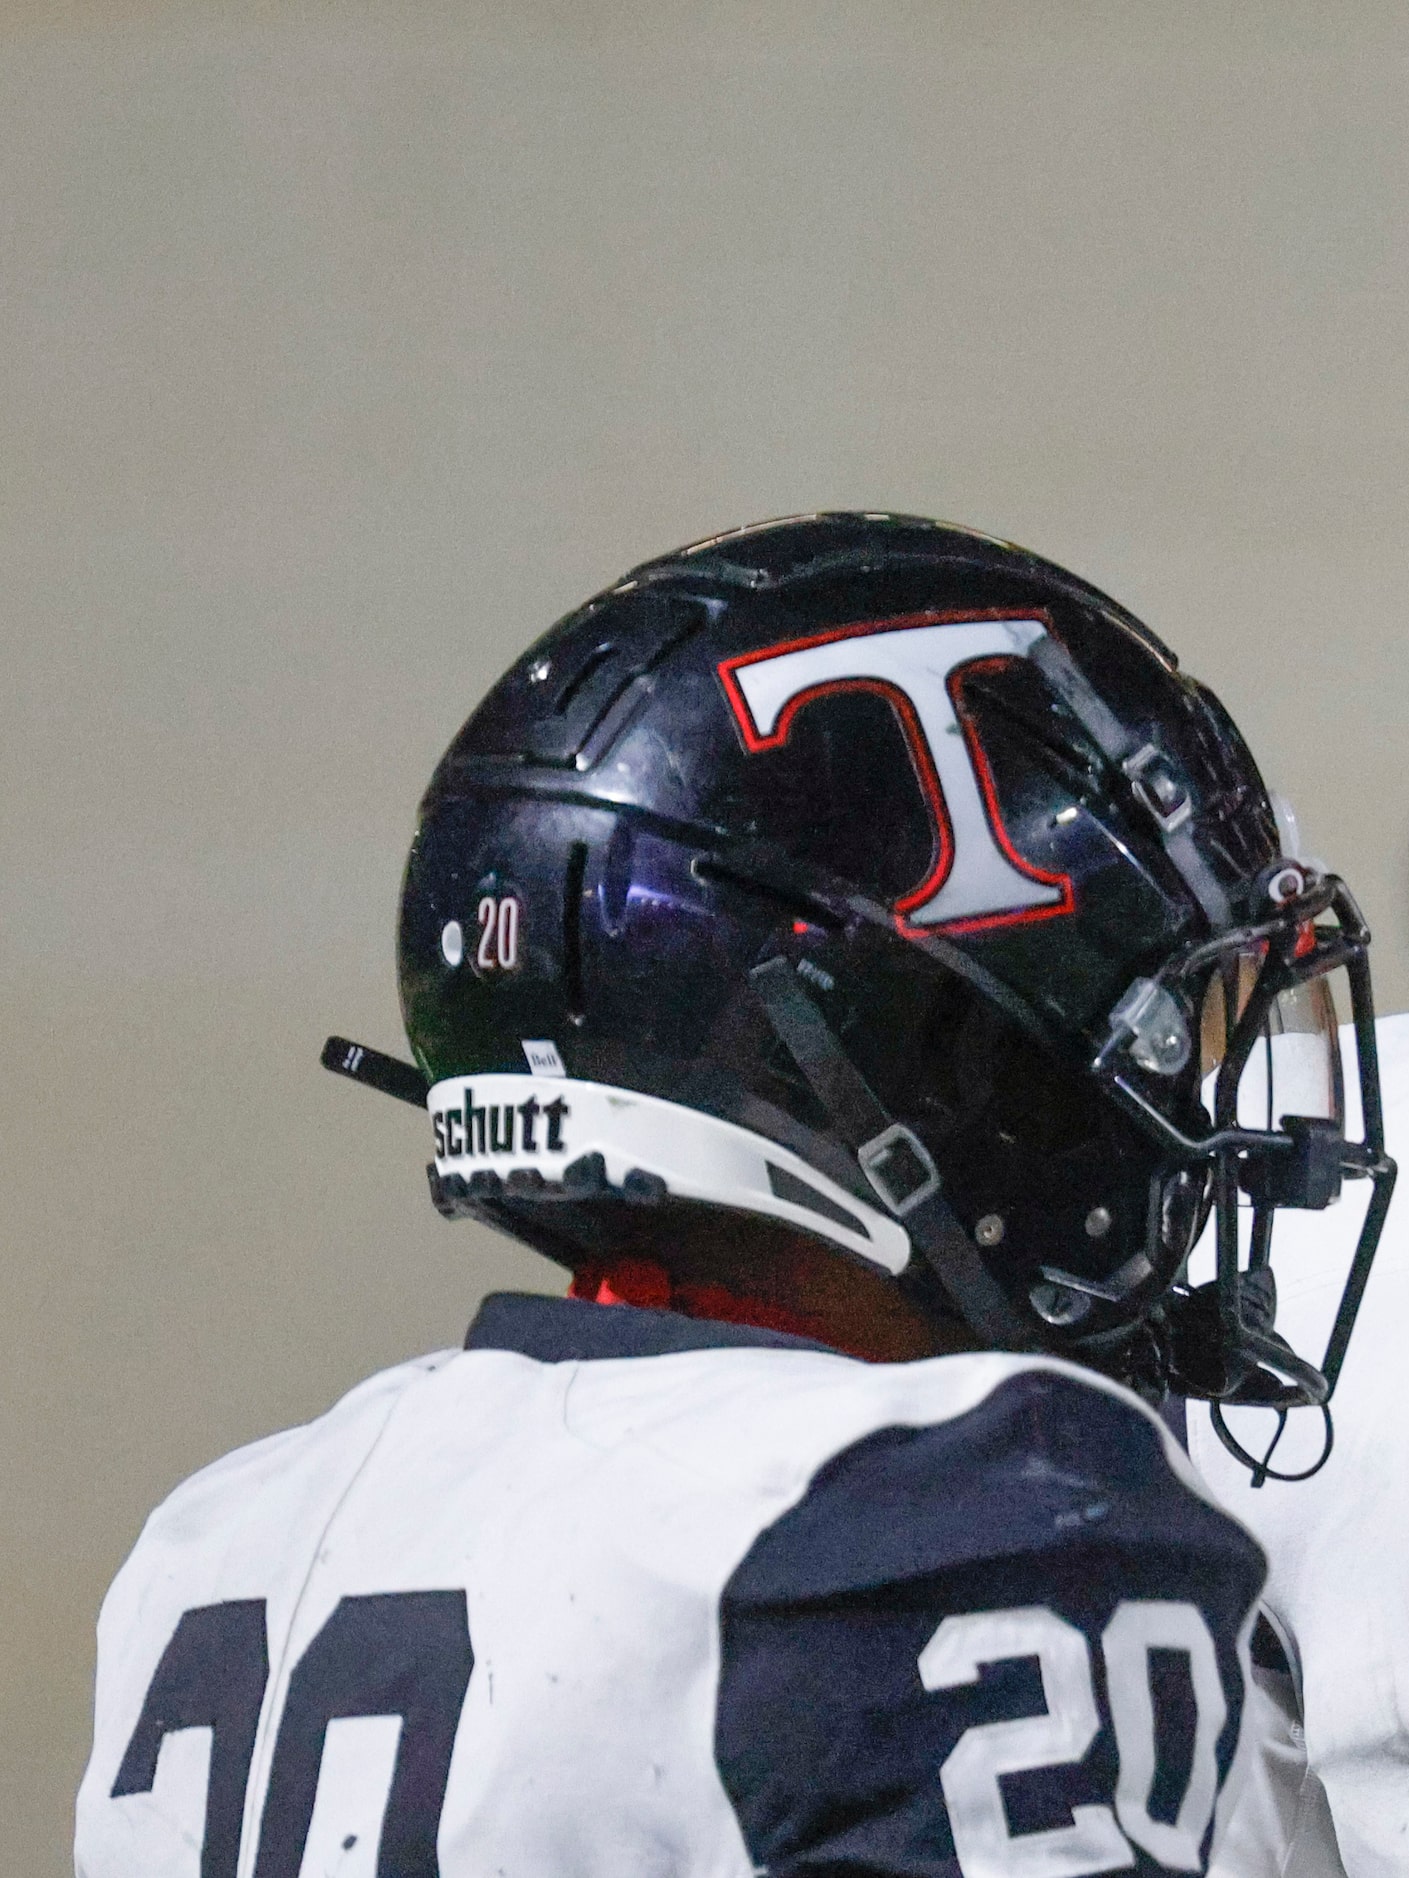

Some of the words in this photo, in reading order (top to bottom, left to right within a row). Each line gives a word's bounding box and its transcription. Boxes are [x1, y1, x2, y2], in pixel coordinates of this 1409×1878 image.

[718, 608, 1073, 938] T
[478, 897, 518, 969] 20
[432, 1086, 570, 1158] schutt
[917, 1600, 1227, 1878] 20
